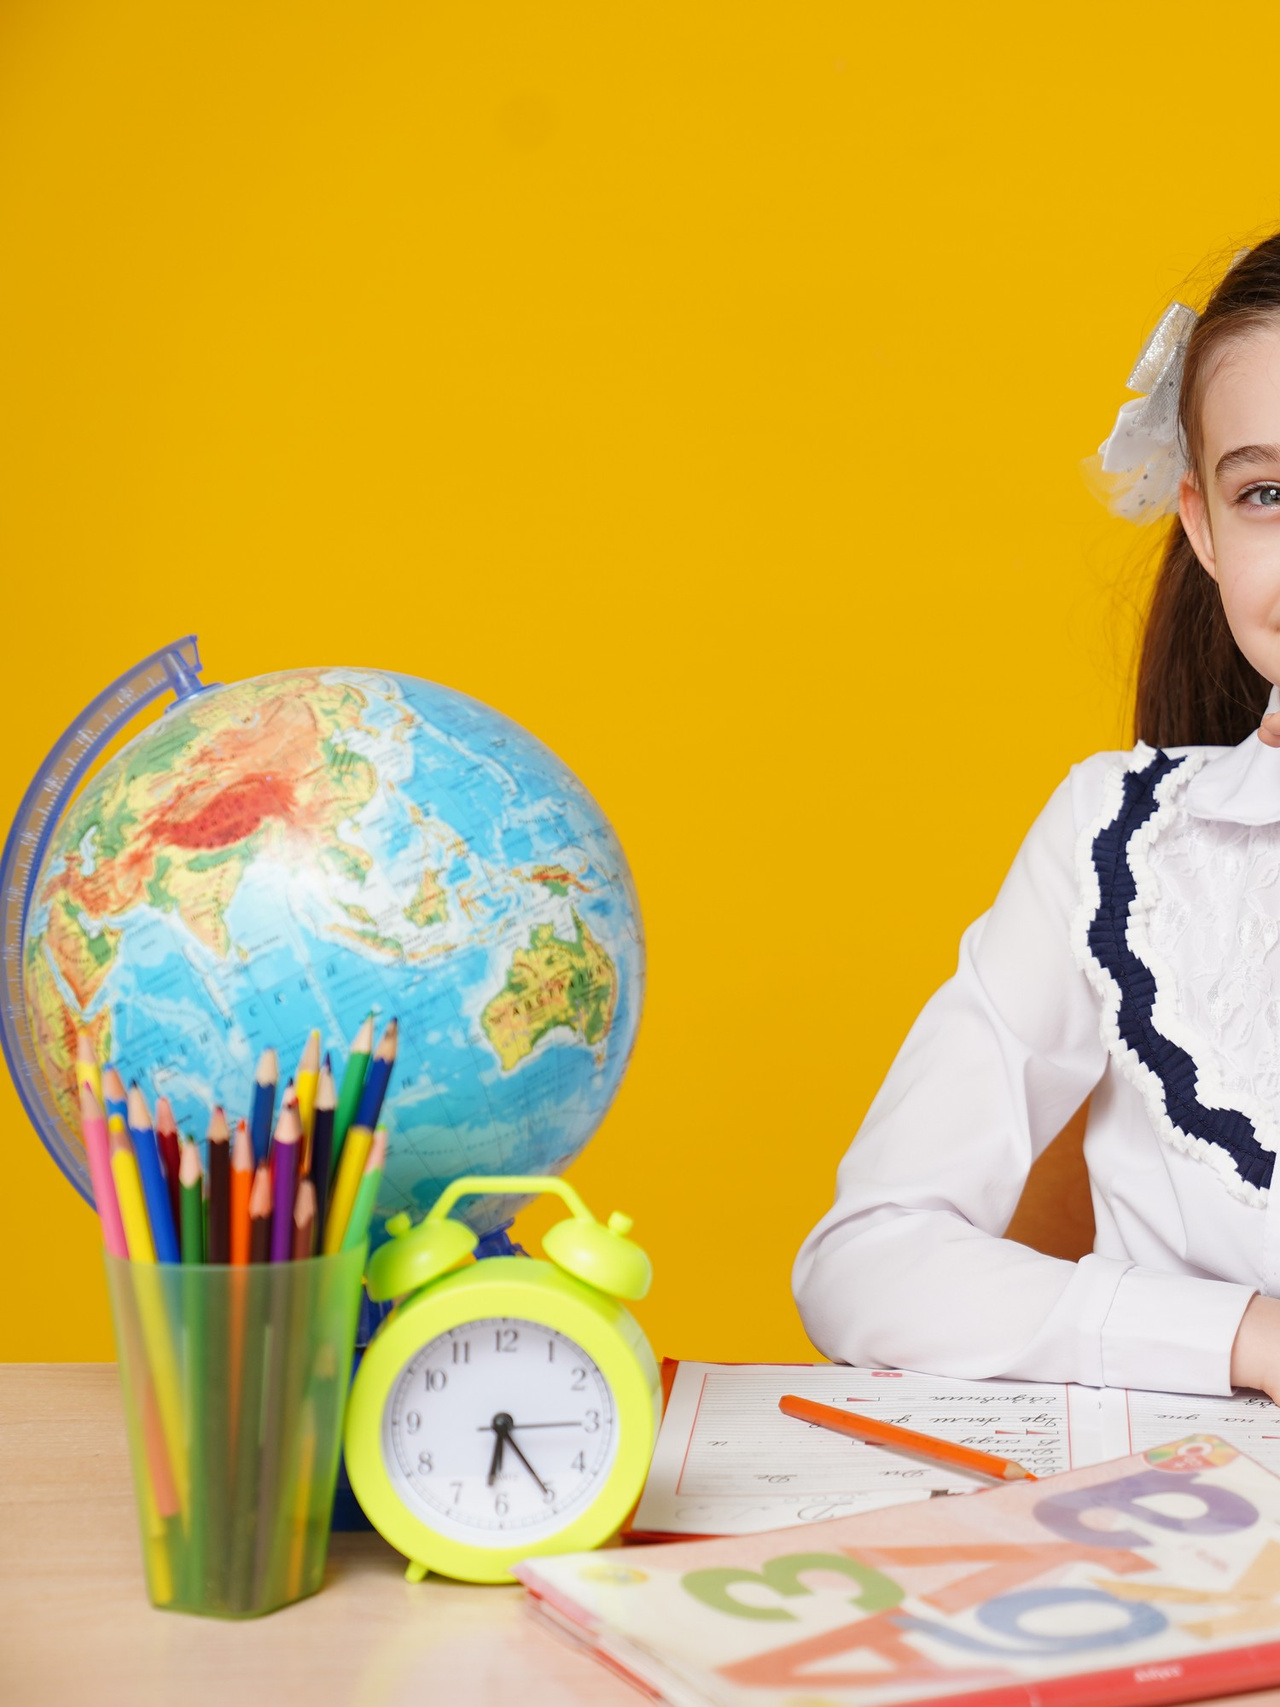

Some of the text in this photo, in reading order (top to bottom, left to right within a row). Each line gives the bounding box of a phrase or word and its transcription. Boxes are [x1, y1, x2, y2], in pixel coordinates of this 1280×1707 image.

[453, 1340, 470, 1364] 11
[494, 1330, 518, 1352] 12
[547, 1340, 555, 1363] 1
[424, 1368, 447, 1392] 10
[571, 1368, 587, 1391] 2
[406, 1411, 421, 1435] 9
[584, 1411, 600, 1433] 3
[417, 1452, 433, 1475] 8
[570, 1451, 587, 1472] 4
[982, 1448, 1062, 1456] Дени
[449, 1482, 464, 1505] 7
[542, 1481, 556, 1505] 5
[494, 1493, 509, 1517] 6
